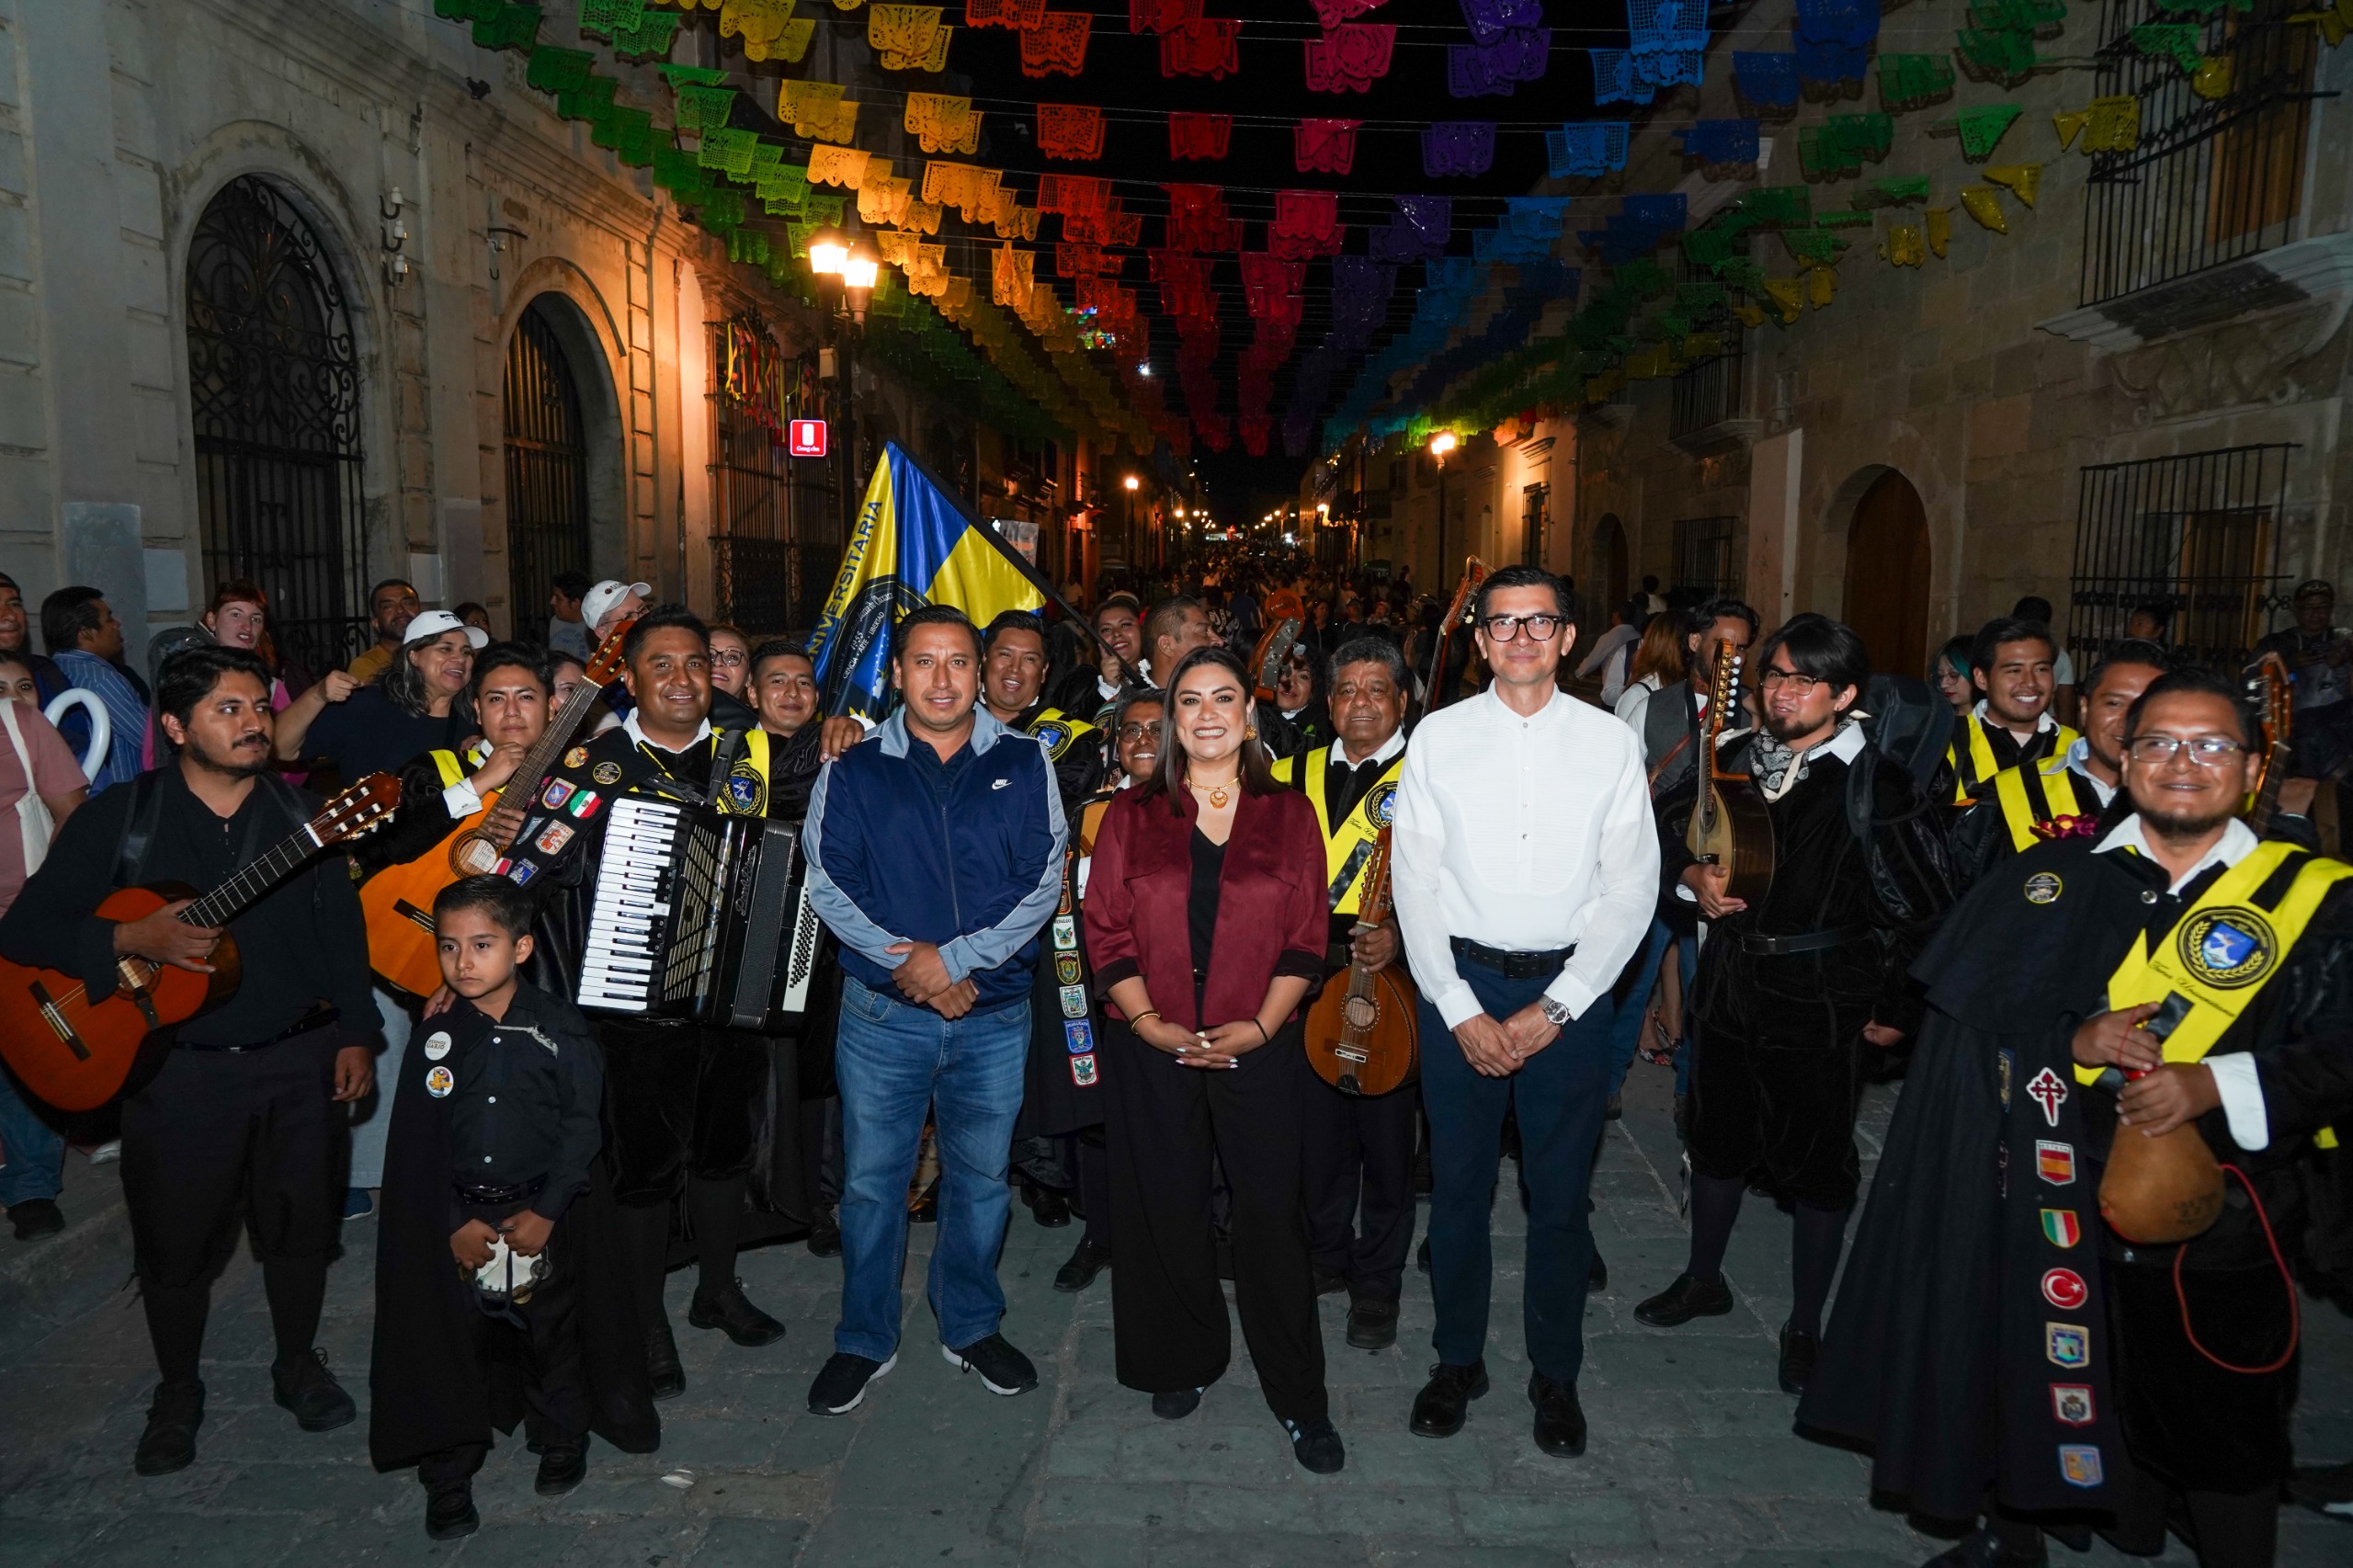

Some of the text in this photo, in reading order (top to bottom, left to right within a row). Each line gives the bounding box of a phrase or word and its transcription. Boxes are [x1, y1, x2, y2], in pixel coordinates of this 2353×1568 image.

[842, 656, 859, 680] CIENCIA
[858, 638, 870, 654] ARTE
[868, 610, 885, 635] LIBERTAD
[850, 631, 864, 651] 1955
